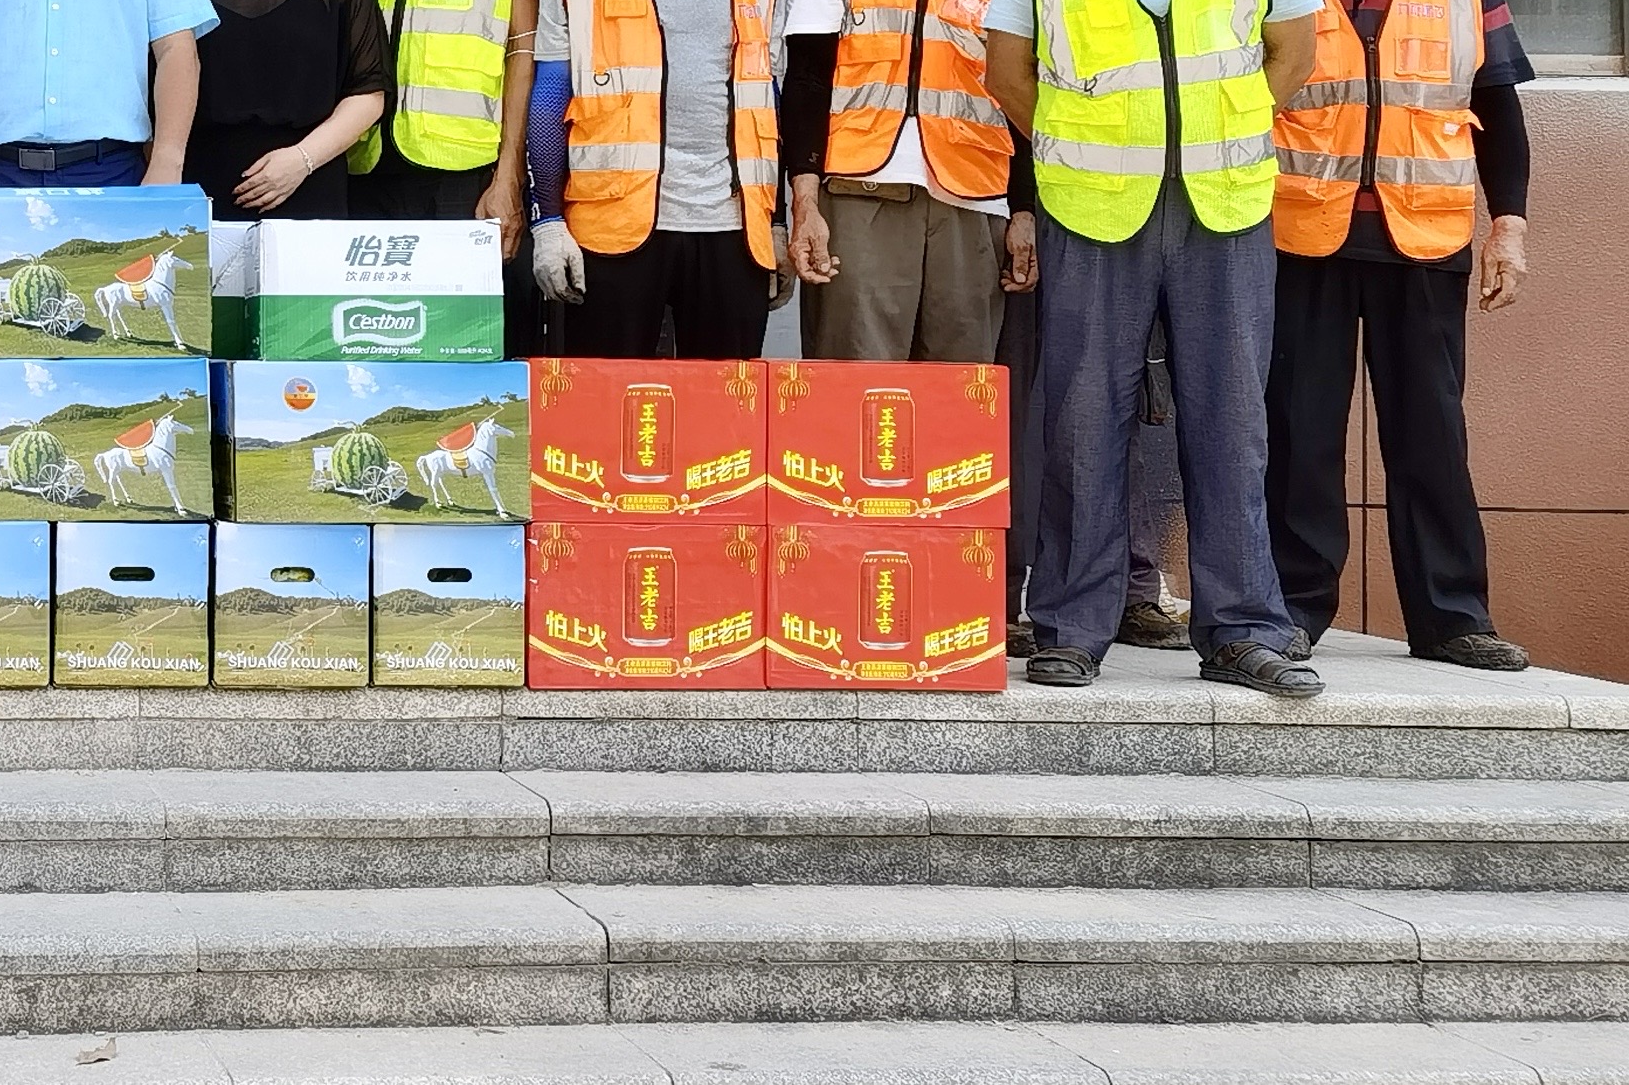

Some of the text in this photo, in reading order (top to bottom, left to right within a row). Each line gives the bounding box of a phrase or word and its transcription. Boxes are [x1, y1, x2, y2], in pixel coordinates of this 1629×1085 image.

[345, 271, 412, 282] 饮用纯净水
[637, 402, 657, 468] 王老吉
[877, 407, 897, 471] 王老吉
[544, 445, 605, 489] 怕上火
[686, 448, 752, 492] 喝王老吉
[783, 450, 846, 492] 怕上火
[927, 452, 994, 495] 喝王老吉
[639, 566, 659, 632] 王老吉
[875, 570, 895, 635] 王老吉
[545, 610, 608, 654] 怕上火
[688, 611, 753, 654] 喝王老吉
[781, 612, 842, 656] 怕上火
[924, 617, 990, 658] 喝王老吉
[5, 656, 39, 669] XIAN
[68, 655, 200, 670] SHUANG KOU XIAN
[228, 655, 359, 670] SHUANG KOU XIAN
[386, 656, 517, 670] SHUANG KOU XIAN
